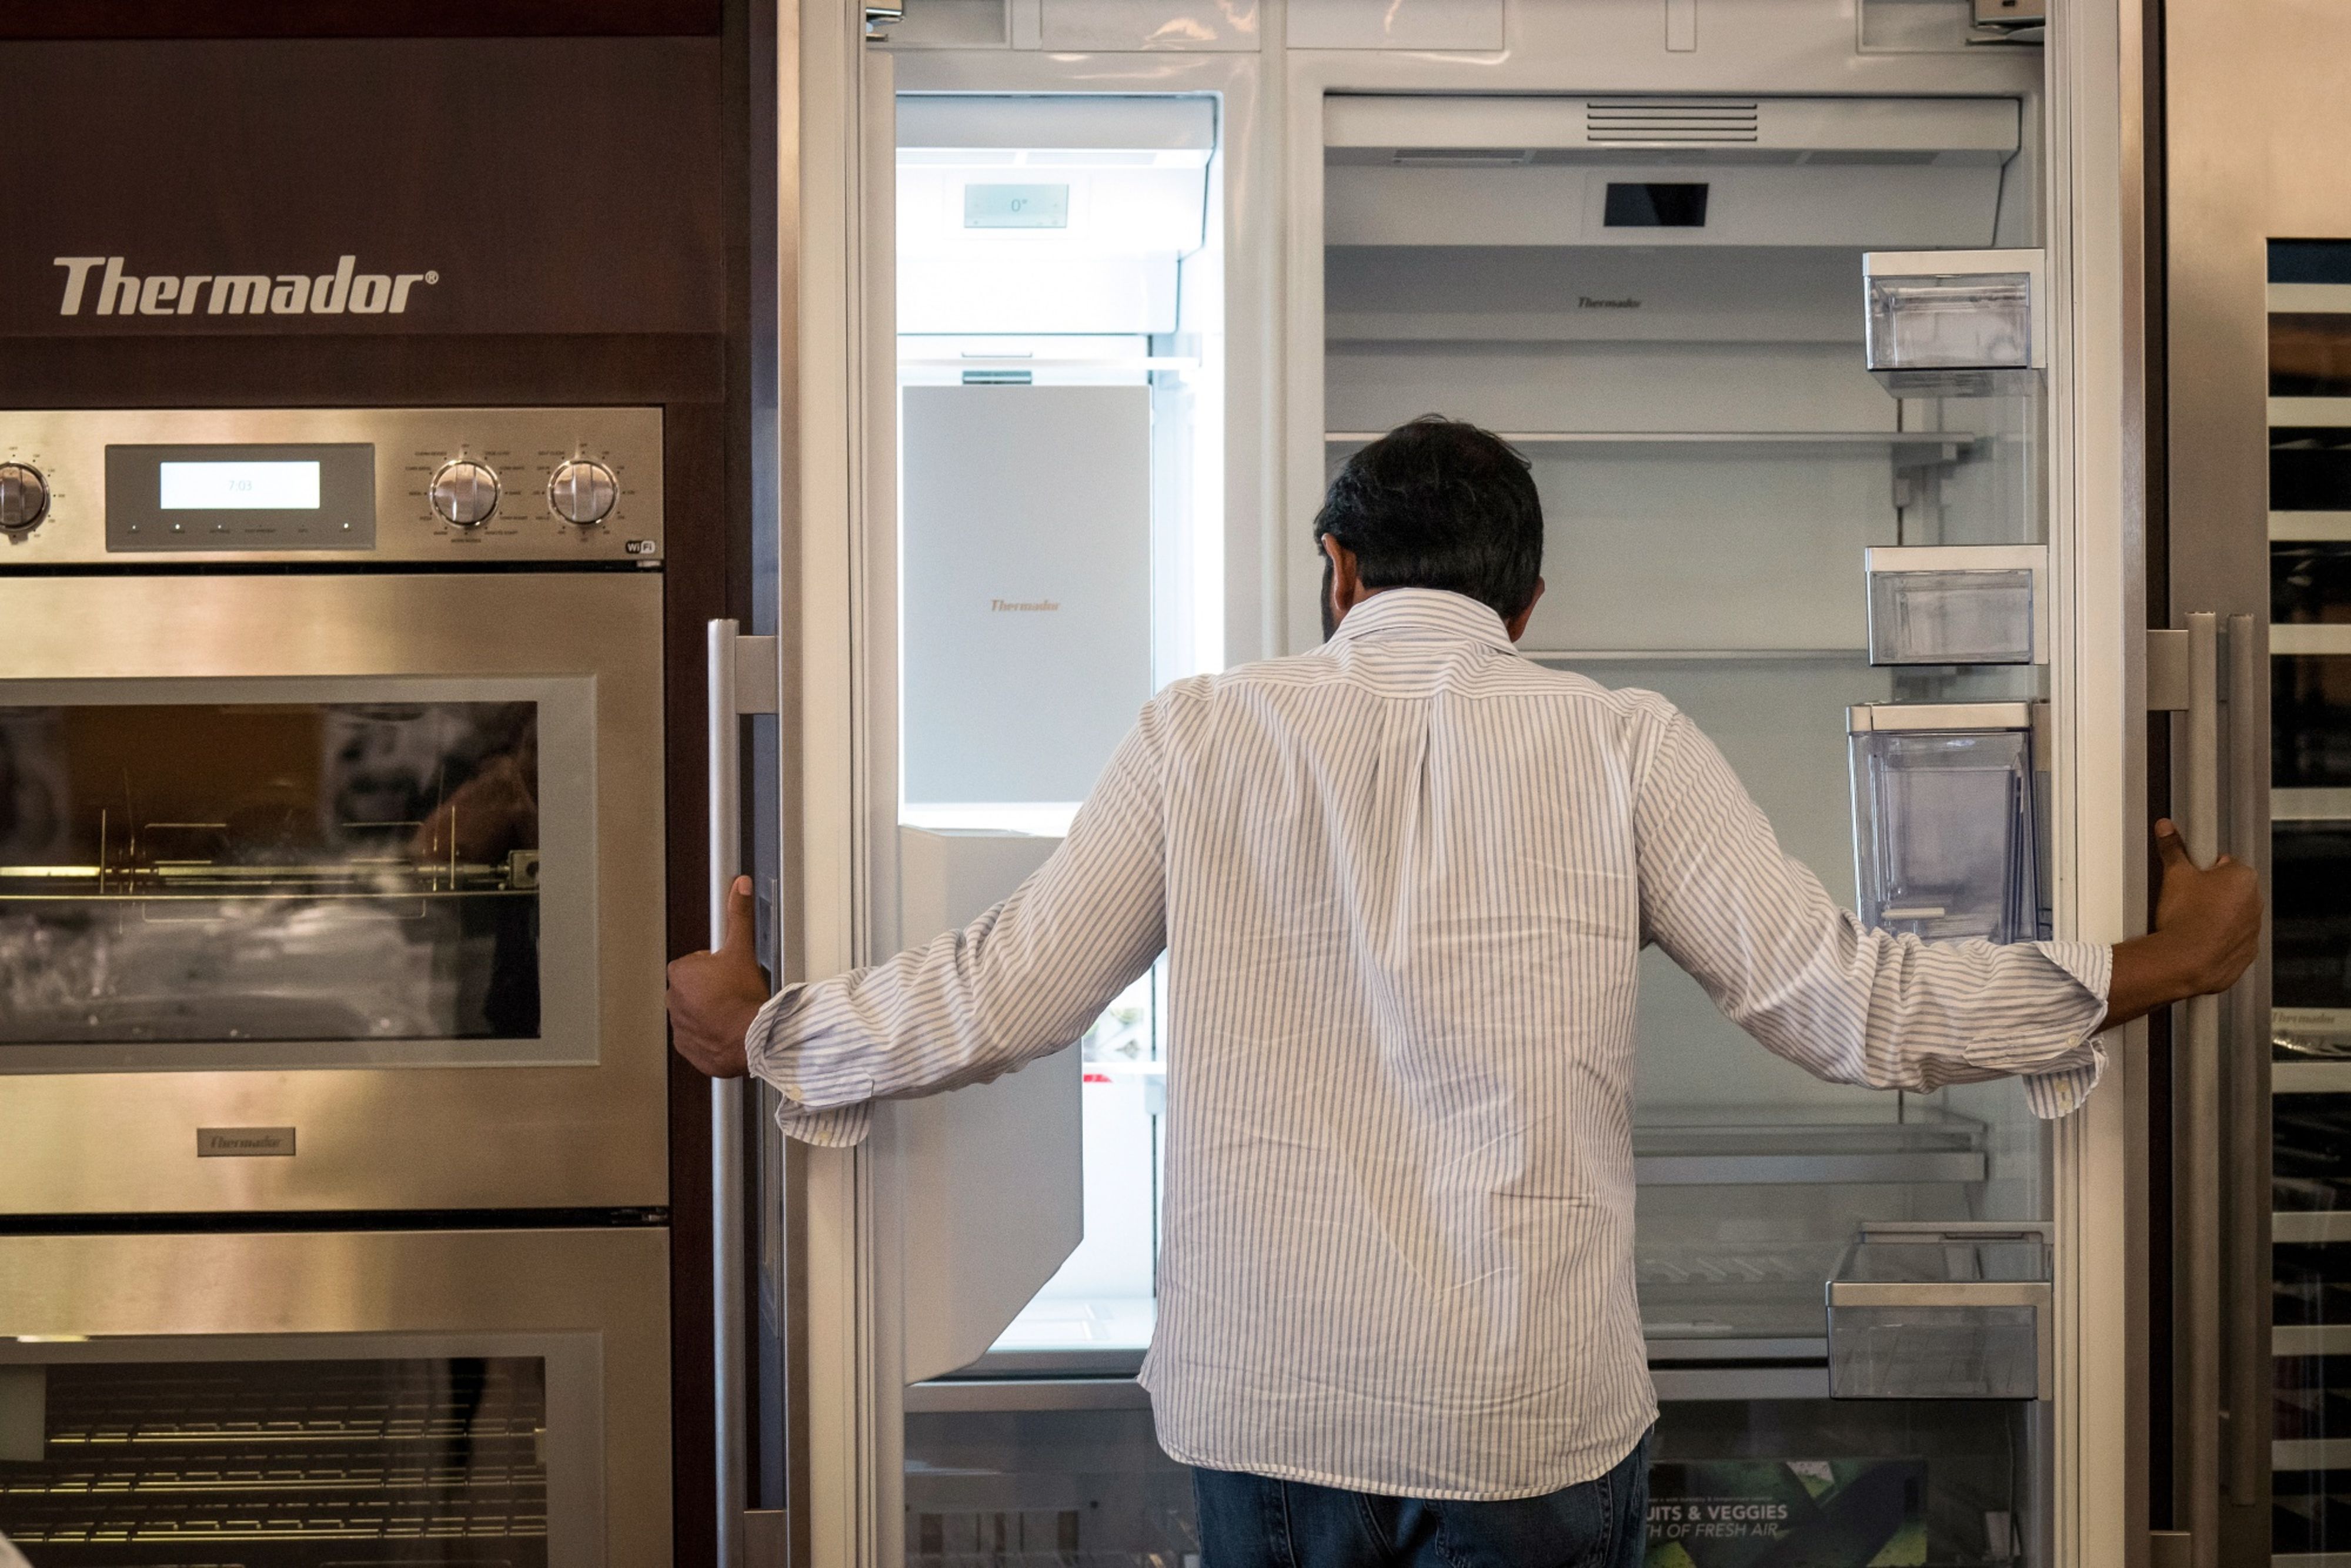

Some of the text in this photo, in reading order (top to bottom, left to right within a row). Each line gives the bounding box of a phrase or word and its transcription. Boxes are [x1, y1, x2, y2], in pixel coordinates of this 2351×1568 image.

[991, 599, 1059, 611] Thermador
[1688, 1506, 1701, 1520] &
[1708, 1505, 1788, 1520] VEGGIES
[1667, 1523, 1691, 1538] OF
[1695, 1523, 1746, 1537] FRESH
[1751, 1522, 1778, 1536] AIR
